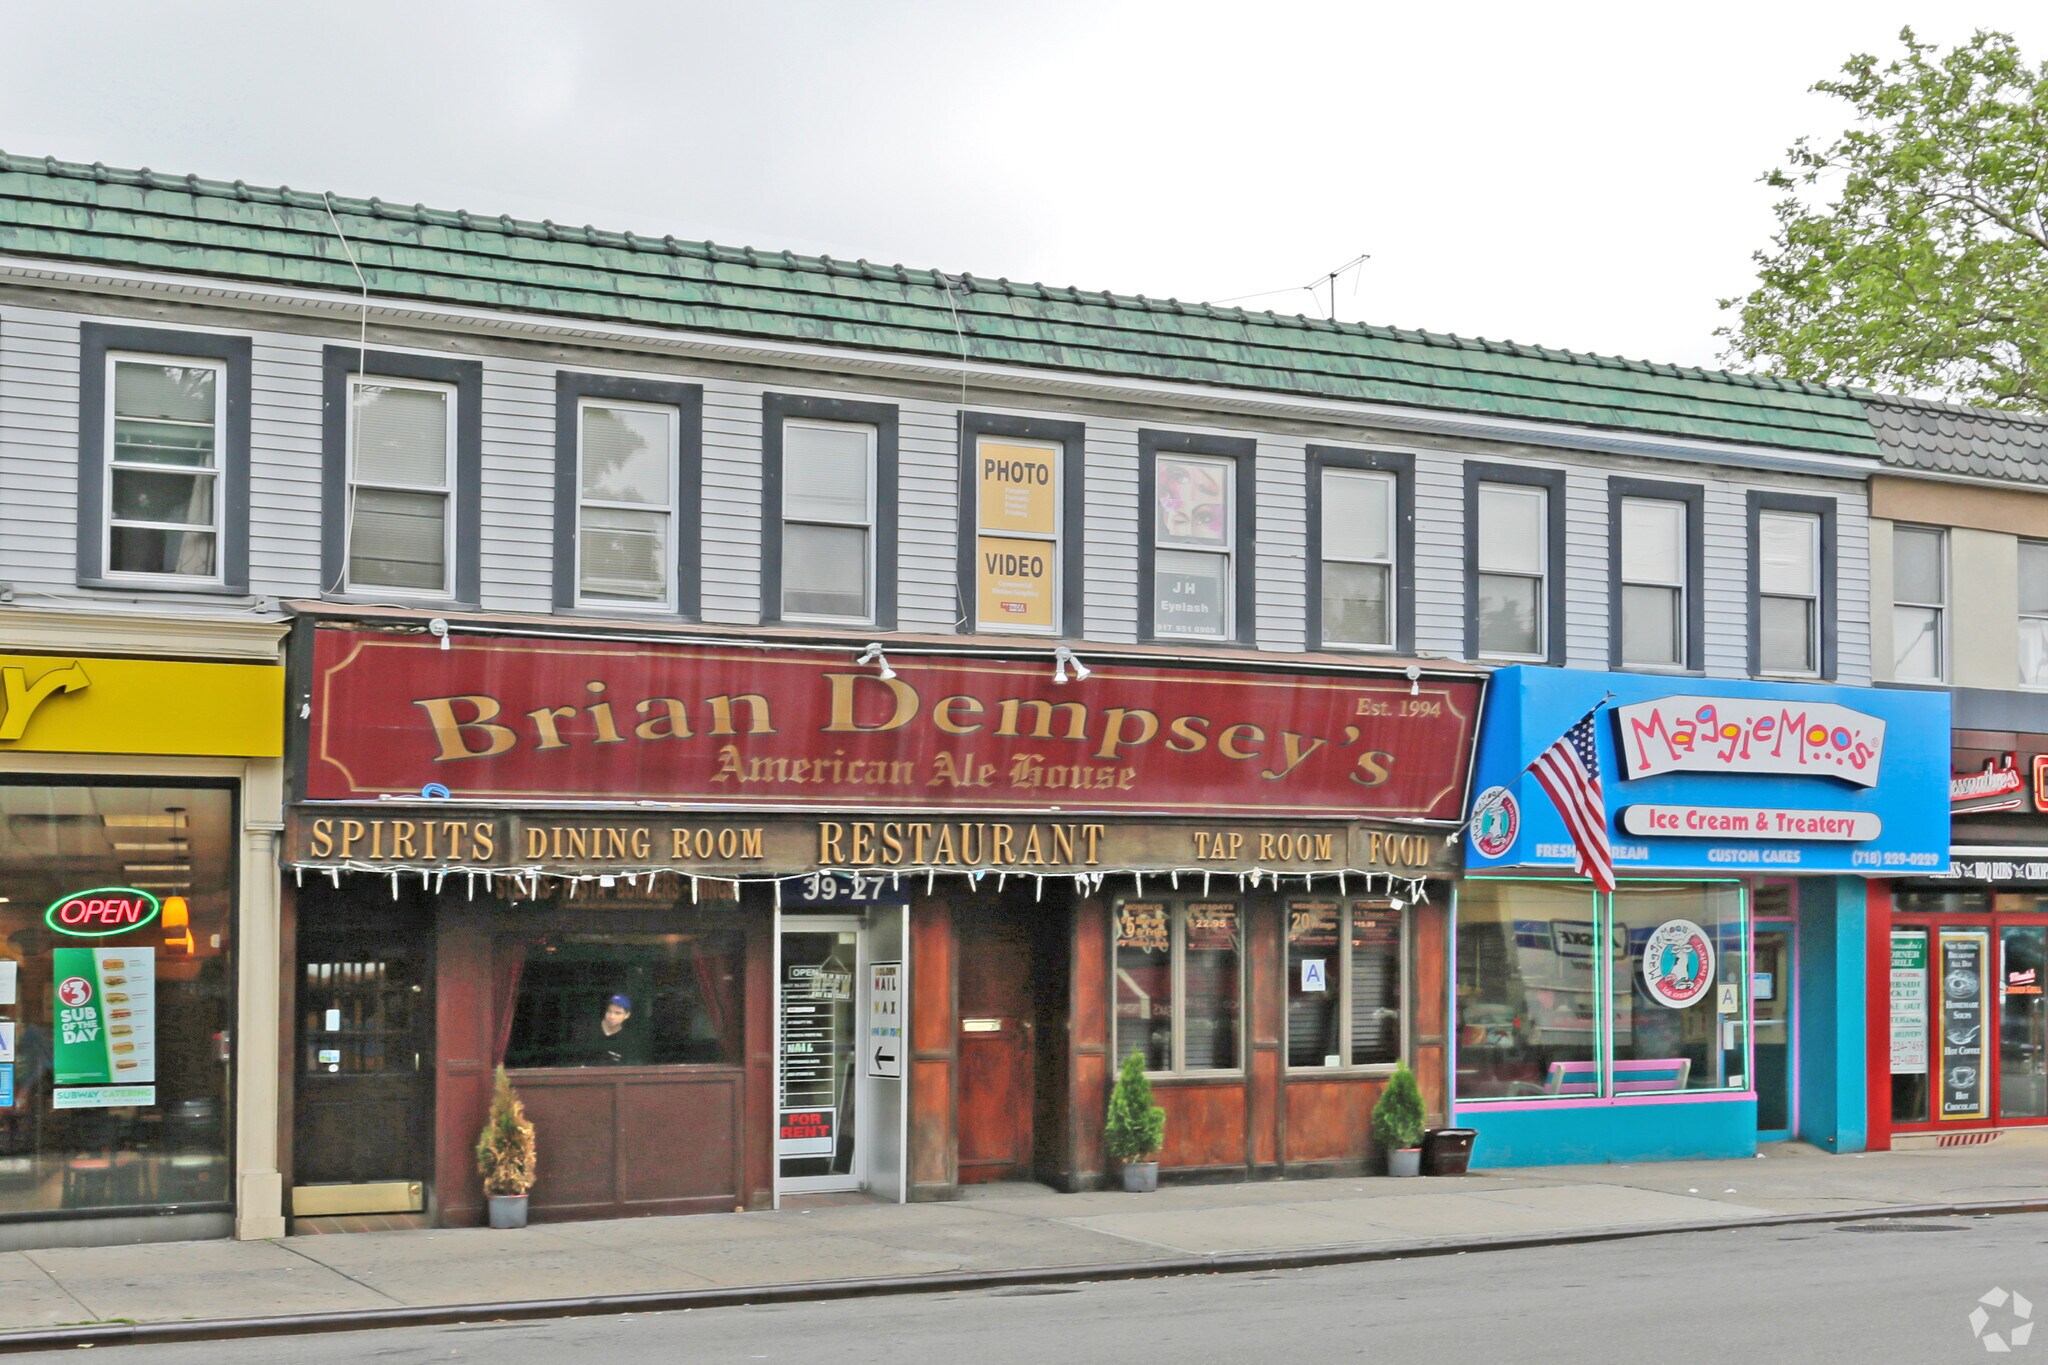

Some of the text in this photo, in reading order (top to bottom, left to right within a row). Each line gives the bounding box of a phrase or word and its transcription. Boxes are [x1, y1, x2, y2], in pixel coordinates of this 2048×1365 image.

[984, 458, 1049, 486] PHOTO
[985, 552, 1044, 578] VIDEO
[1161, 600, 1209, 613] Eyelash
[1356, 698, 1441, 718] Est. 1994
[413, 670, 1396, 787] Brian Dempsey's
[710, 744, 1137, 795] American Ale House
[1650, 809, 1855, 838] Ice Cream & Treatery
[310, 819, 495, 861] SPIRITS
[526, 827, 764, 860] DINING ROOM
[818, 822, 1105, 866] RESTAURANT
[1195, 831, 1333, 862] TAP ROOM
[1369, 831, 1430, 868] FOOD
[1536, 844, 1649, 860] FRESH REAM
[1707, 849, 1801, 863] CUSTOM CAKES
[1852, 850, 1939, 867] (718) 229-0229
[803, 877, 885, 900] 39-27
[61, 899, 142, 924] OPEN
[793, 968, 819, 977] OPEN
[1306, 964, 1321, 983] A
[62, 980, 87, 1005] $3
[874, 978, 897, 991] NAIL
[1723, 987, 1733, 1005] A
[60, 1006, 97, 1023] SUB
[62, 1020, 98, 1031] OF THE
[63, 1028, 99, 1045] DAY
[787, 1043, 814, 1053] NAIL
[56, 1088, 152, 1100] SUBWAY CATERING
[788, 1113, 821, 1125] FOR
[780, 1124, 830, 1138] RENT
